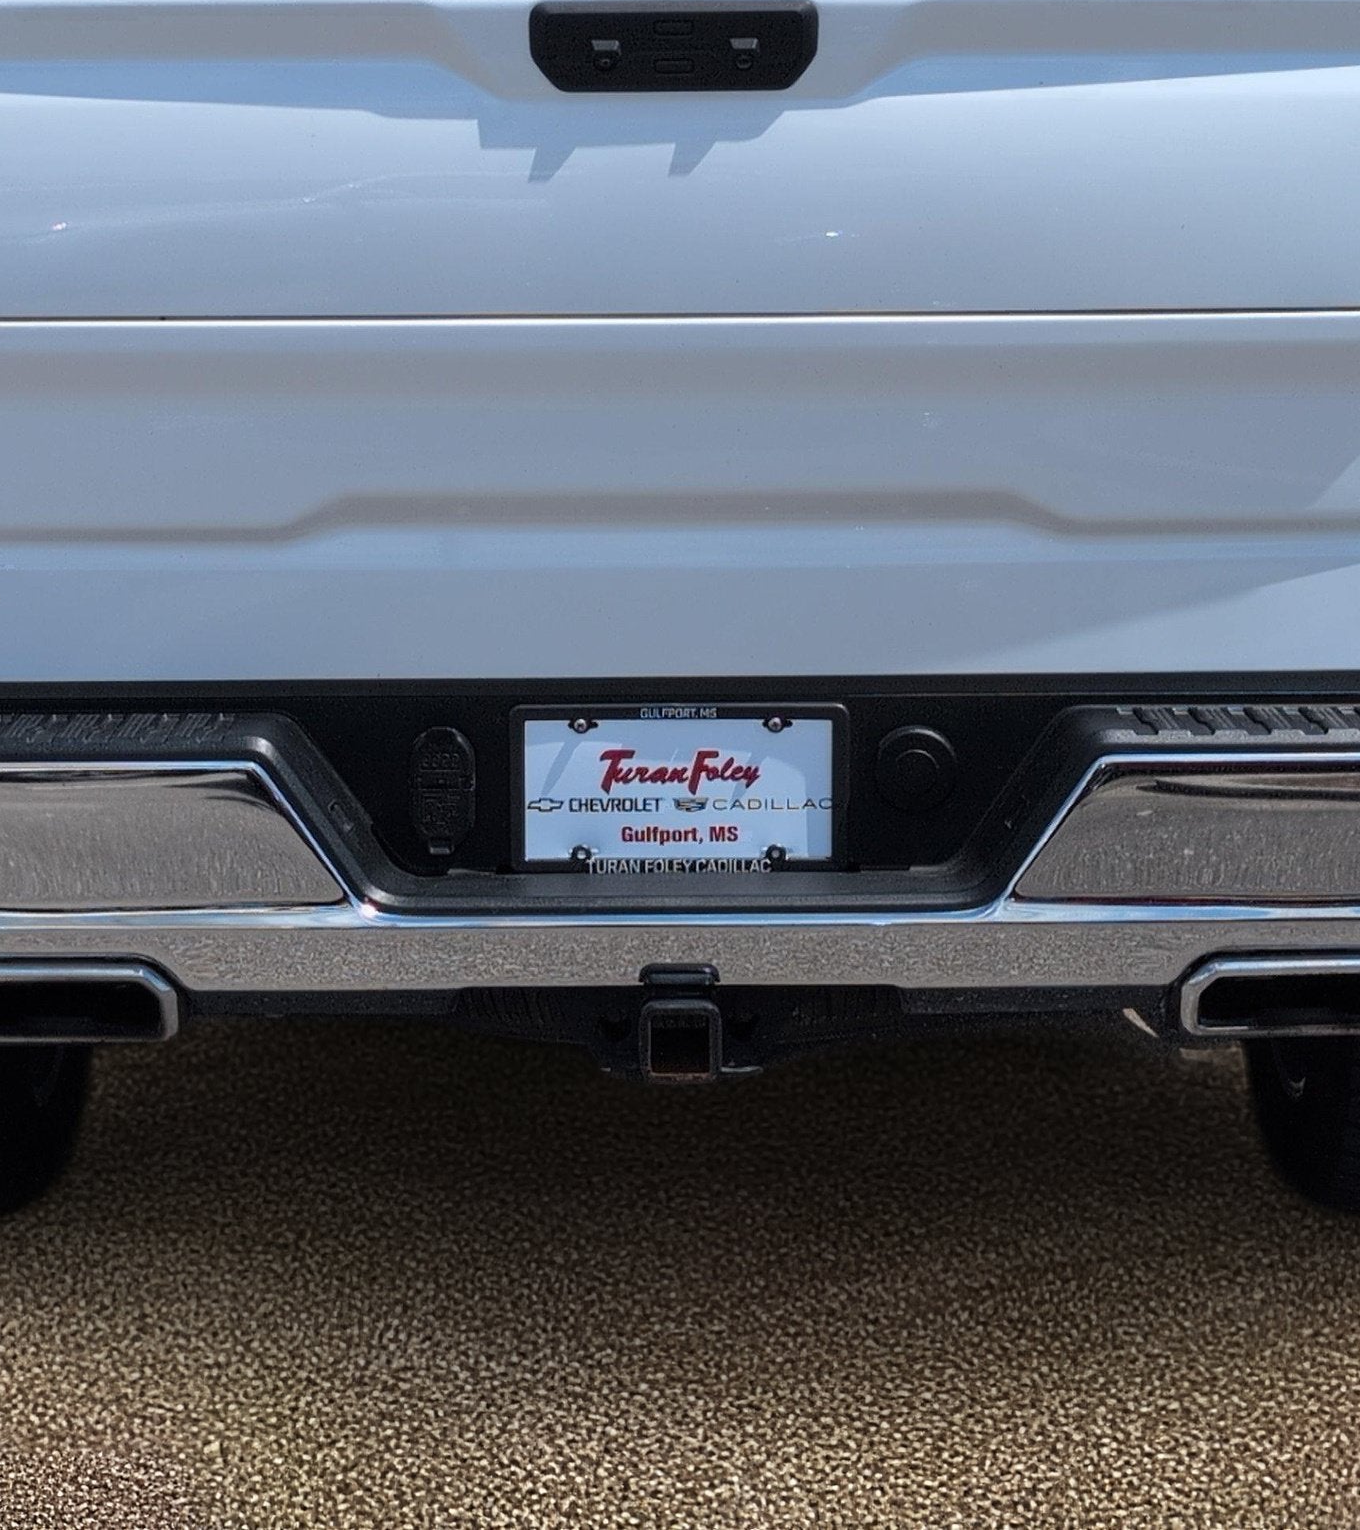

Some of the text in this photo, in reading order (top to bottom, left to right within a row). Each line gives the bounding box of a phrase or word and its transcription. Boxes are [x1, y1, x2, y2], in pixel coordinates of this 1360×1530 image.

[599, 749, 760, 796] Turan Foley
[568, 797, 834, 813] CHEVROLET CADILLAC
[621, 826, 738, 844] Gulfport, MS
[586, 858, 772, 874] TURAN FOLEY CADILLAC
